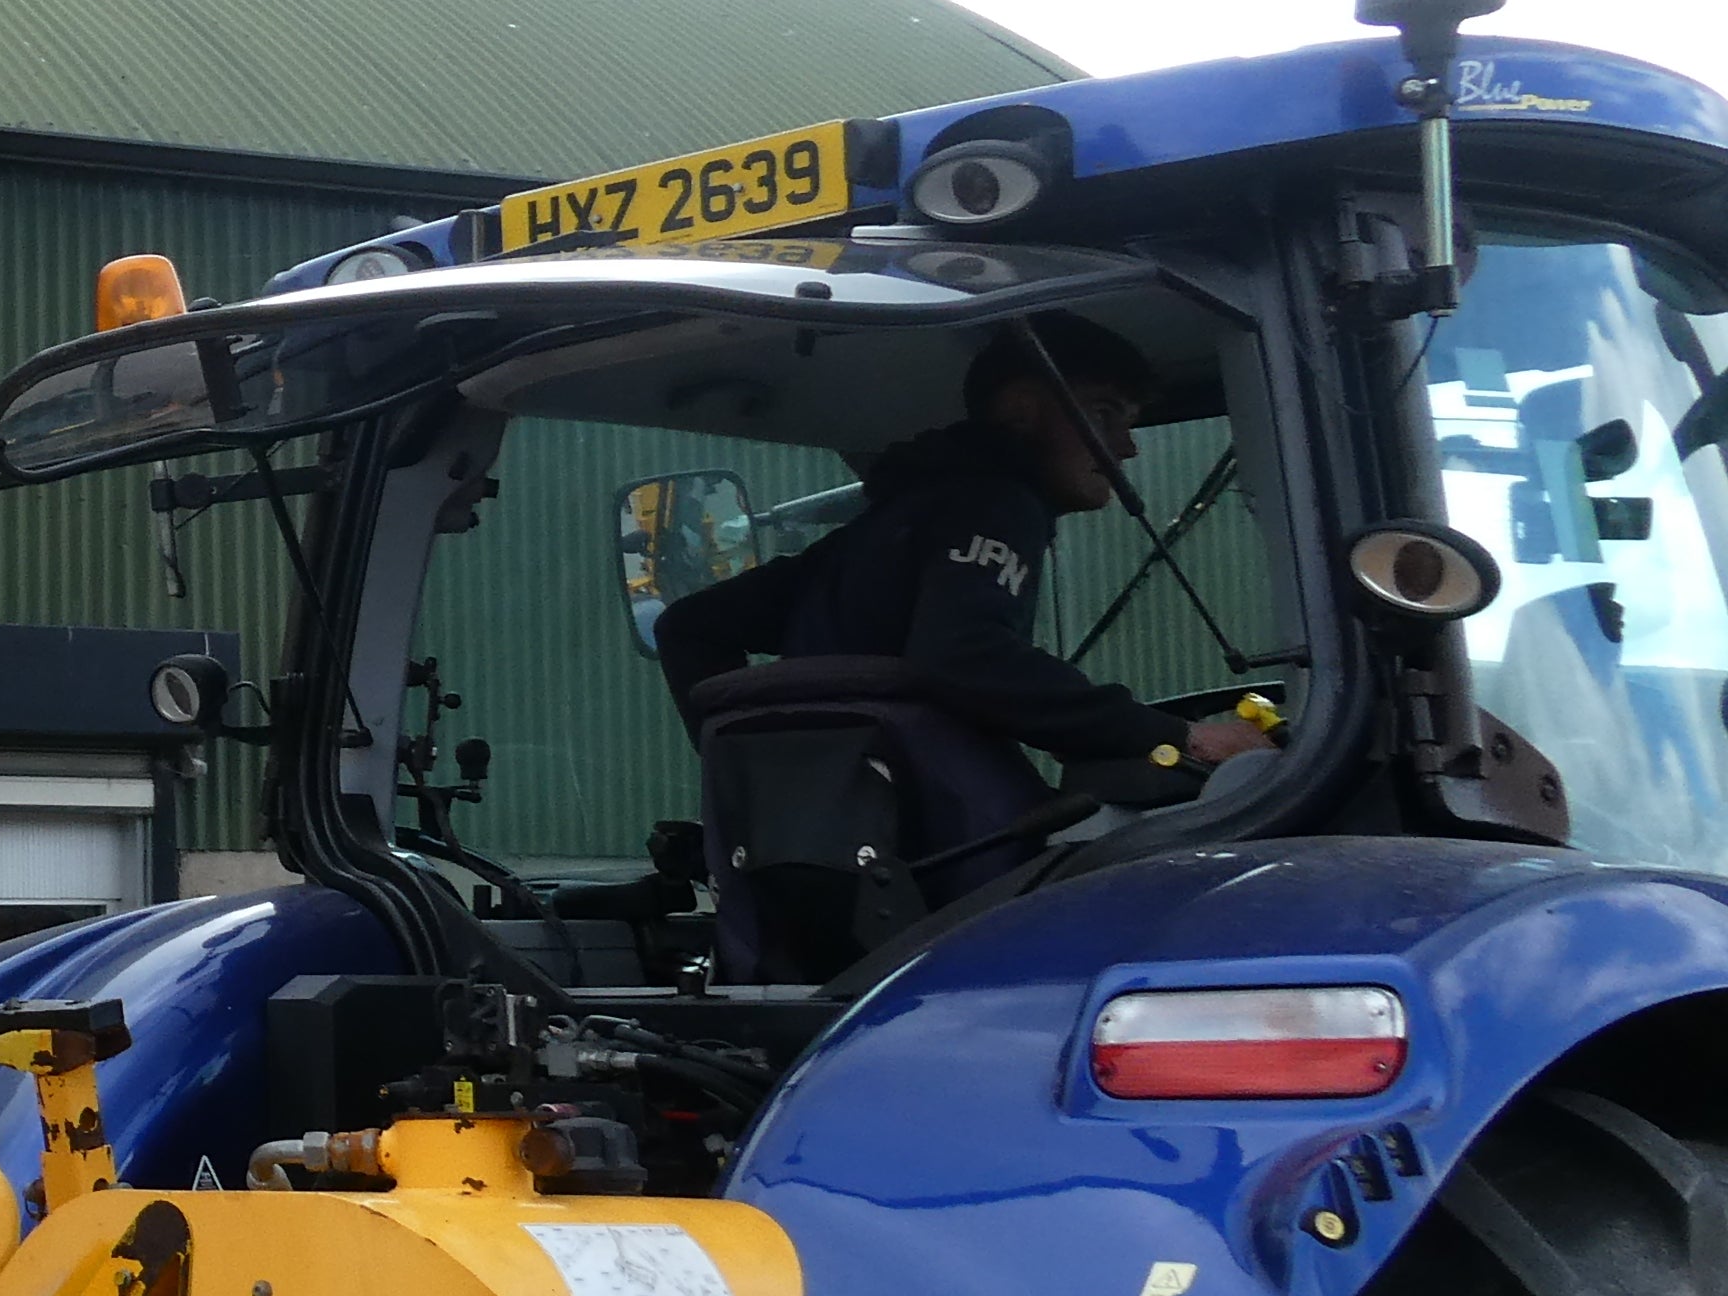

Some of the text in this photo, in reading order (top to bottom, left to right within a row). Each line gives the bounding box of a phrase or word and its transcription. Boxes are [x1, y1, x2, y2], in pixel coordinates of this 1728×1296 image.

[1455, 60, 1522, 104] Blue
[528, 139, 820, 244] HXZ 2639
[948, 535, 1029, 597] JPN
